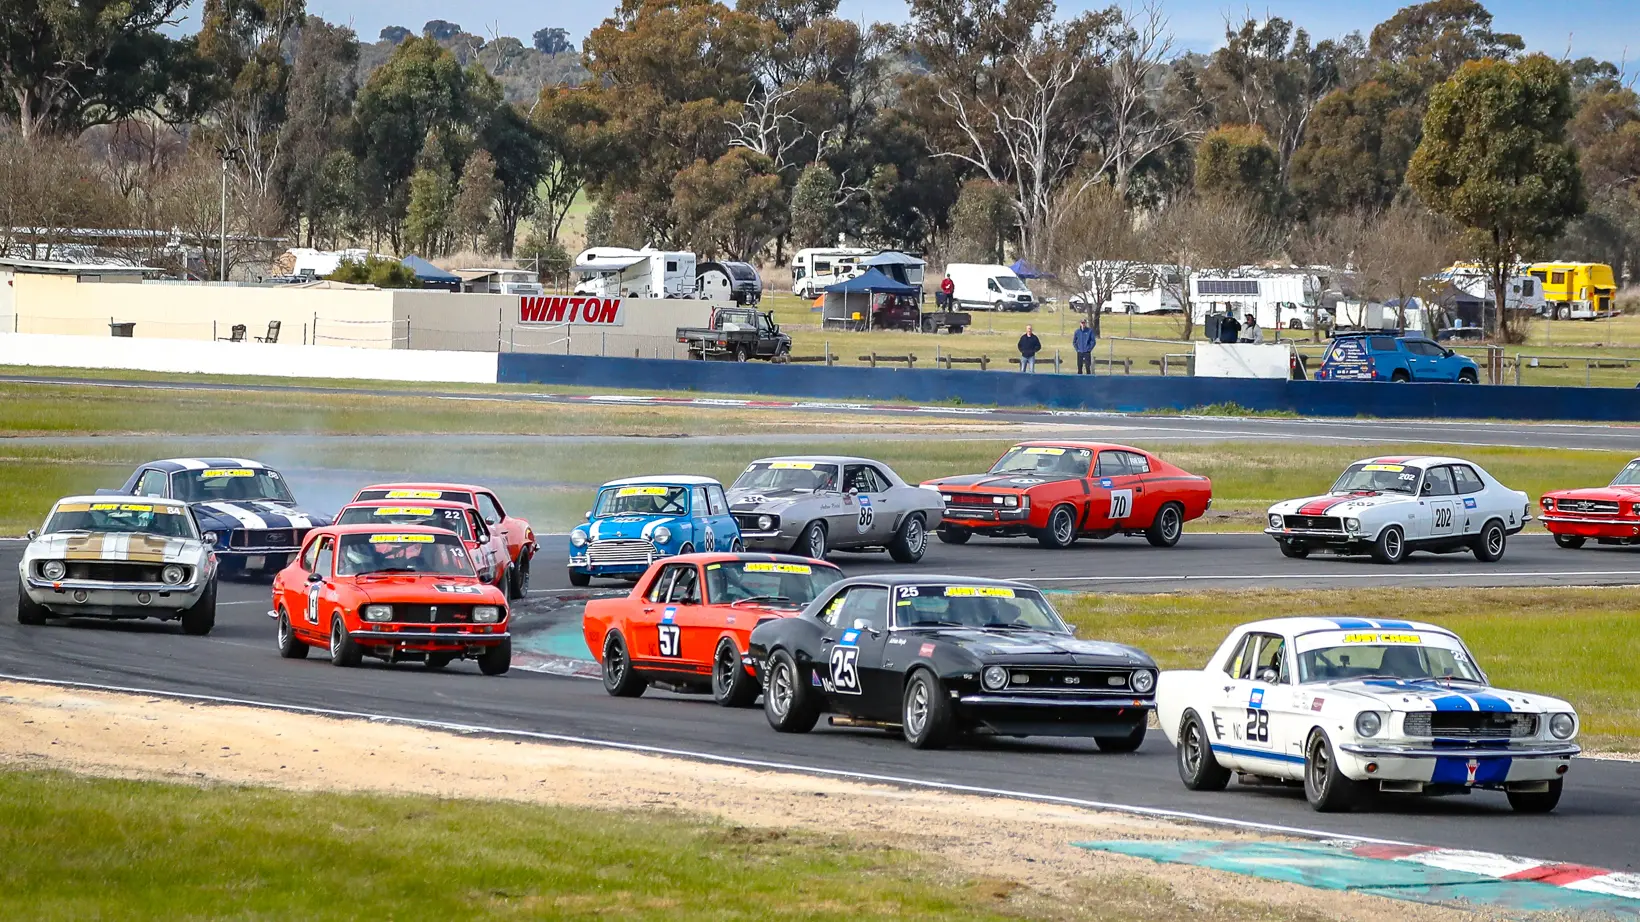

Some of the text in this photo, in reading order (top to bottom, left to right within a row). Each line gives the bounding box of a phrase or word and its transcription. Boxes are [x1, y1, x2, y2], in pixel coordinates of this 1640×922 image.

[521, 297, 620, 323] WINTON
[1398, 473, 1415, 481] 202
[121, 504, 153, 512] CARS
[167, 507, 180, 515] 84
[1112, 496, 1126, 517] 70
[444, 511, 460, 519] 22
[859, 507, 872, 525] 86
[1435, 508, 1451, 527] 202
[706, 532, 714, 552] 88
[450, 549, 464, 557] 13
[745, 563, 811, 574] JUST CARS
[900, 587, 919, 598] 25
[945, 587, 1015, 598] JUST CARS
[658, 625, 680, 656] 57
[1342, 633, 1421, 644] JUST CARS
[1451, 650, 1468, 662] 28
[832, 649, 856, 688] 25
[1233, 722, 1242, 740] NC
[1246, 708, 1269, 742] 28
